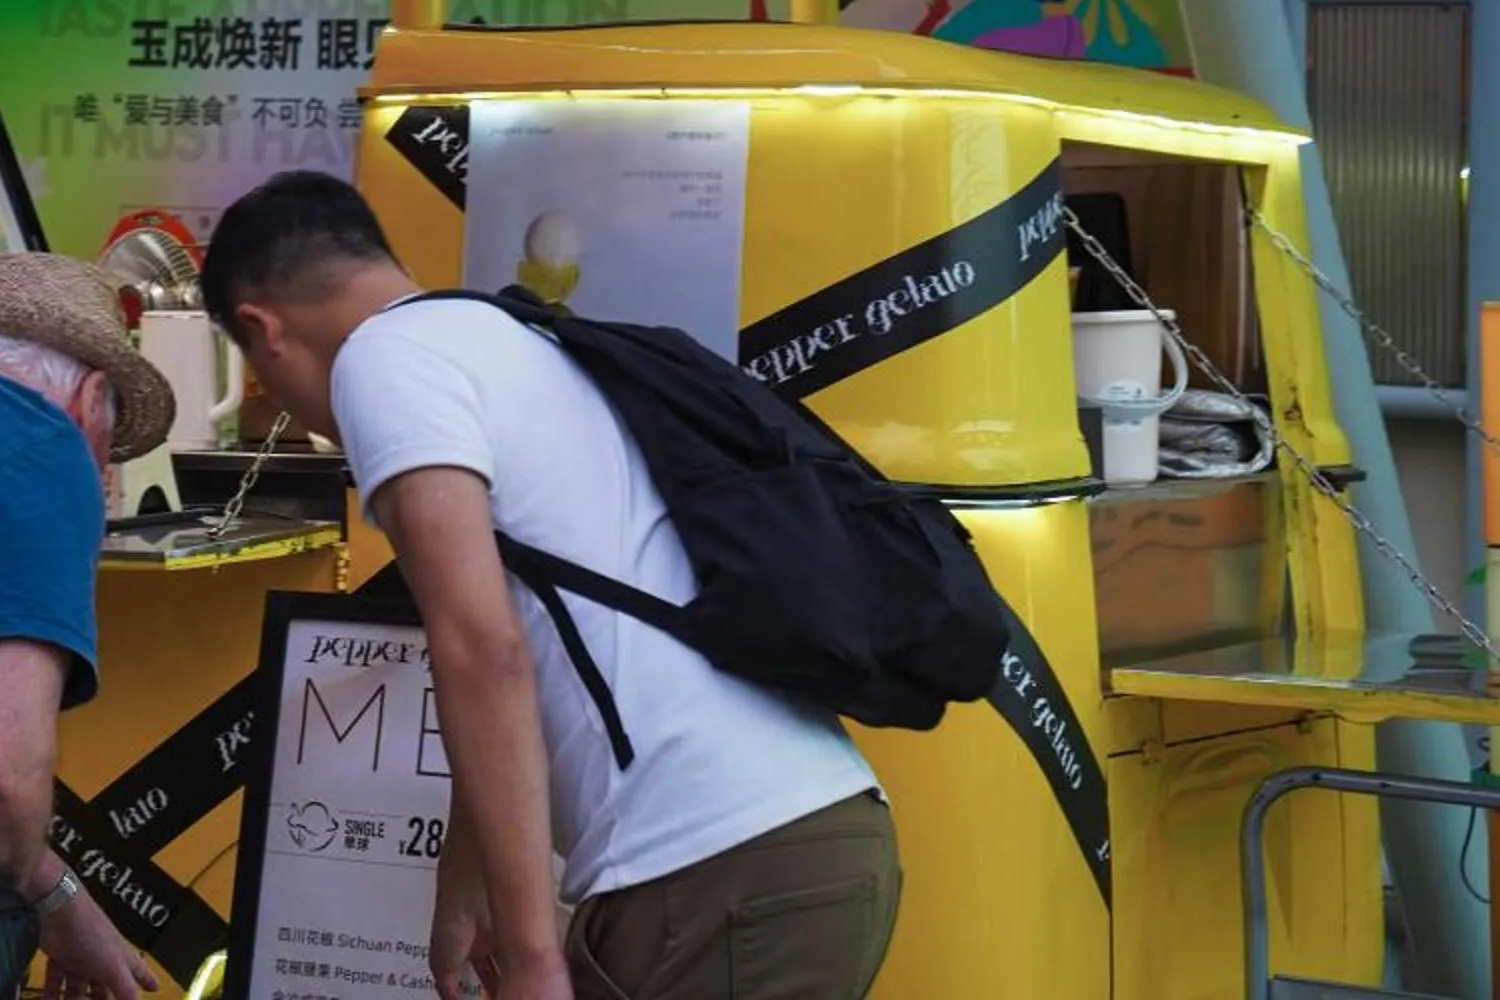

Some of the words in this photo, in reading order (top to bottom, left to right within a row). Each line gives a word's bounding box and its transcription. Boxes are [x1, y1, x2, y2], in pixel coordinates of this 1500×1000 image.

[128, 17, 304, 71] 玉成焕新
[251, 96, 327, 129] 不可负
[743, 313, 861, 384] epper
[865, 260, 976, 337] gelato
[303, 635, 416, 667] pepper
[1032, 697, 1082, 791] gelato
[344, 818, 386, 839] SINGLE
[80, 849, 171, 928] gelato
[337, 932, 393, 952] Sichuan
[334, 966, 384, 985] Pepper
[387, 971, 398, 987] &
